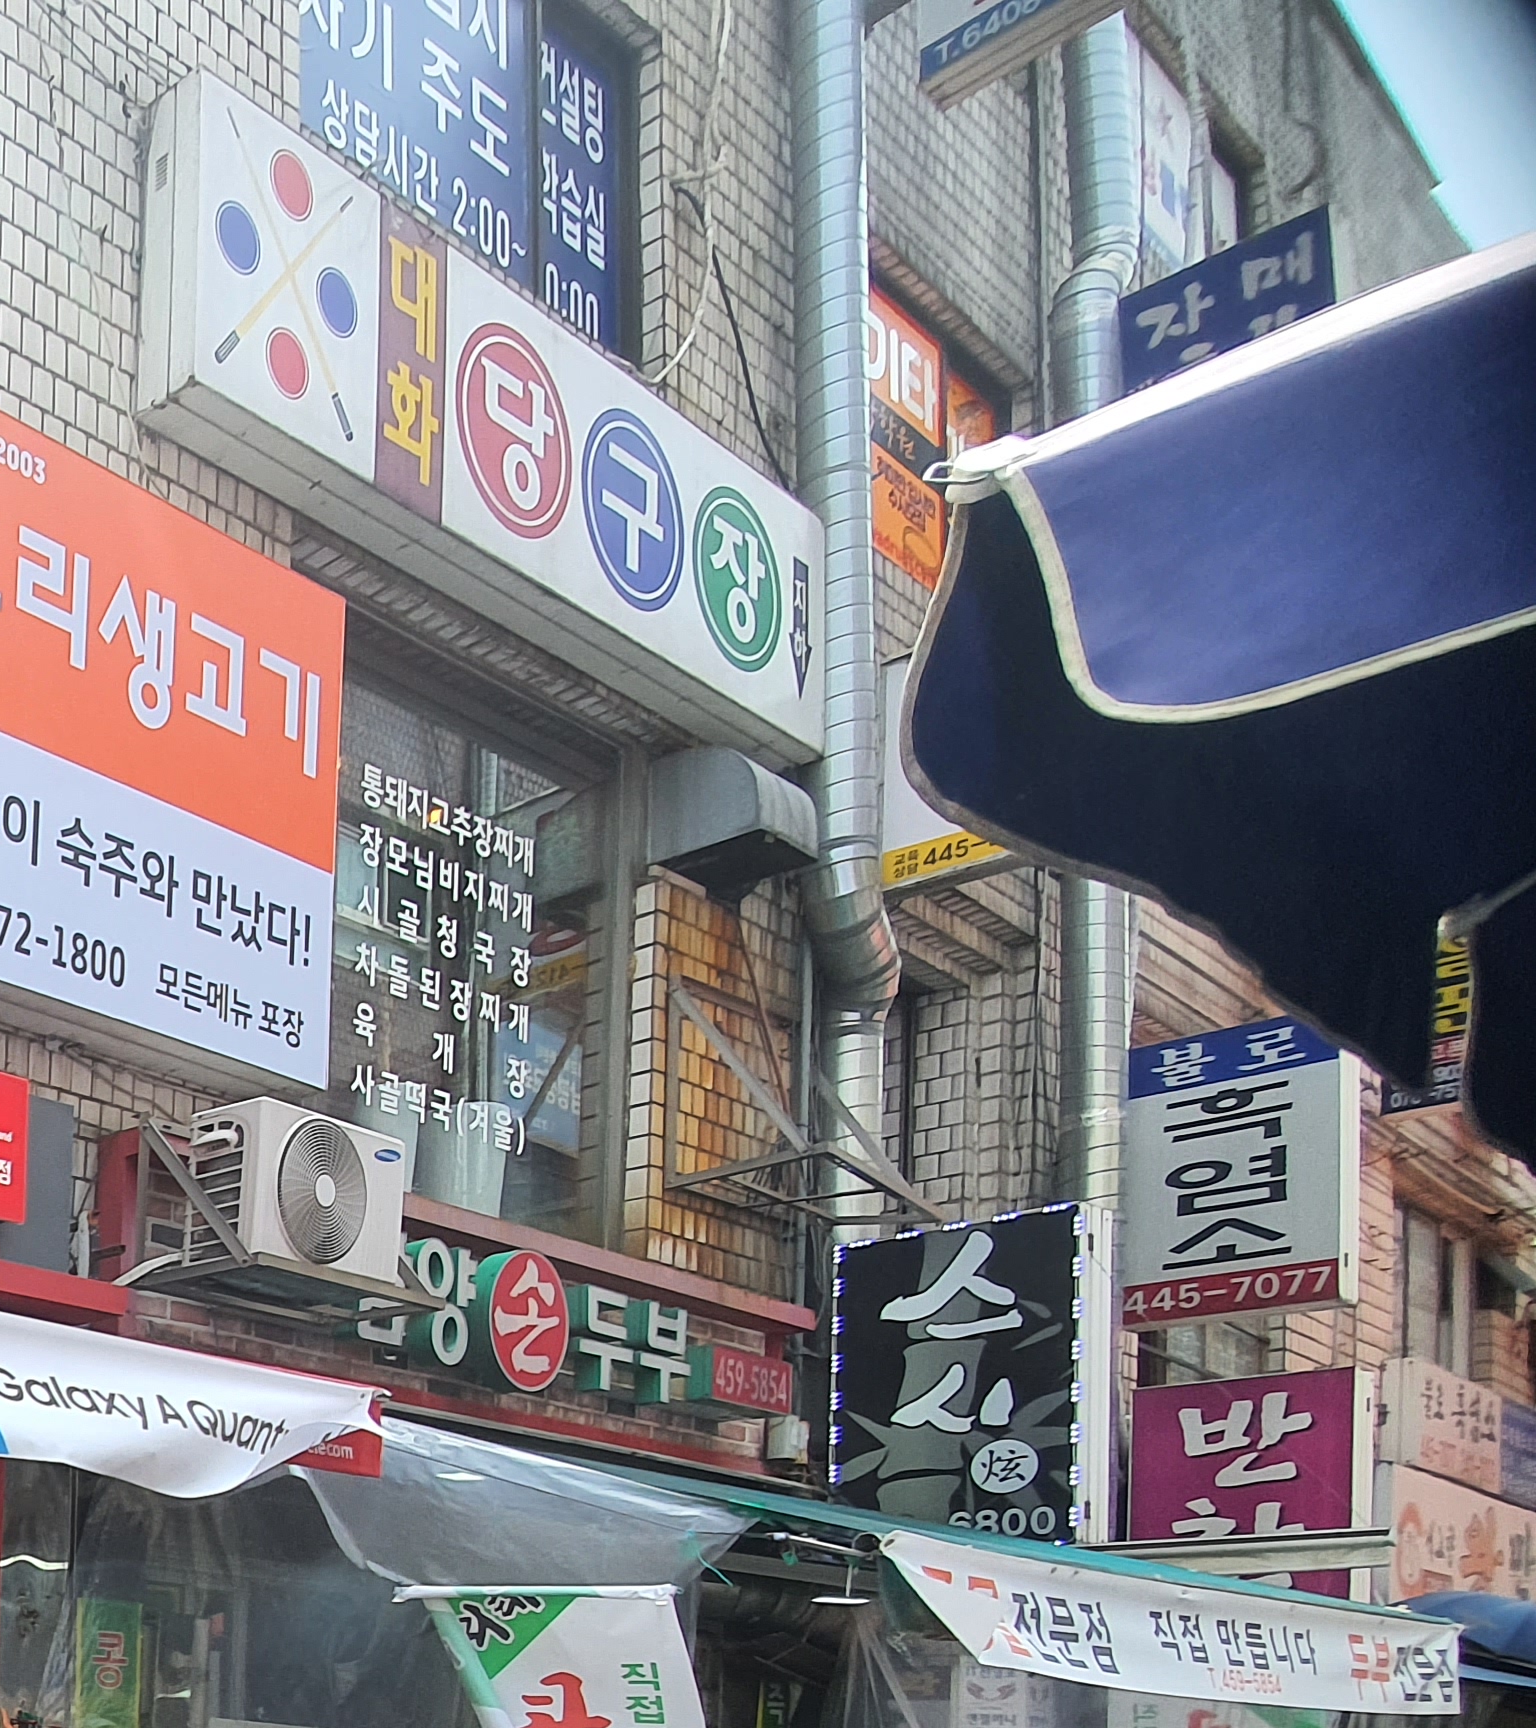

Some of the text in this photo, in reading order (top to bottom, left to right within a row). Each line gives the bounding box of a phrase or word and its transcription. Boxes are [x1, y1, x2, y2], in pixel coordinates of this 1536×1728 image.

[322, 79, 439, 217] 상담시간
[382, 234, 441, 487] 대화
[481, 353, 766, 644] 당구장
[361, 763, 535, 877] 통돼지고추장찌개
[55, 816, 180, 918] 숙주와
[192, 875, 311, 968] 만났다!
[359, 823, 533, 933] 장모님비지찌개
[155, 962, 304, 1049] 모든메뉴 포장
[1151, 1026, 1307, 1085] 불로
[1161, 1080, 1292, 1270] 흑염소
[880, 1231, 1023, 1433] 스시
[1123, 1265, 1332, 1318] 445-7077
[158, 1395, 188, 1430] A
[186, 1400, 290, 1456] Quant
[715, 1354, 788, 1405] 459-5854
[1012, 1591, 1120, 1675] 전문점
[1149, 1610, 1209, 1665] 직접
[1217, 1618, 1319, 1676] 만듭니다
